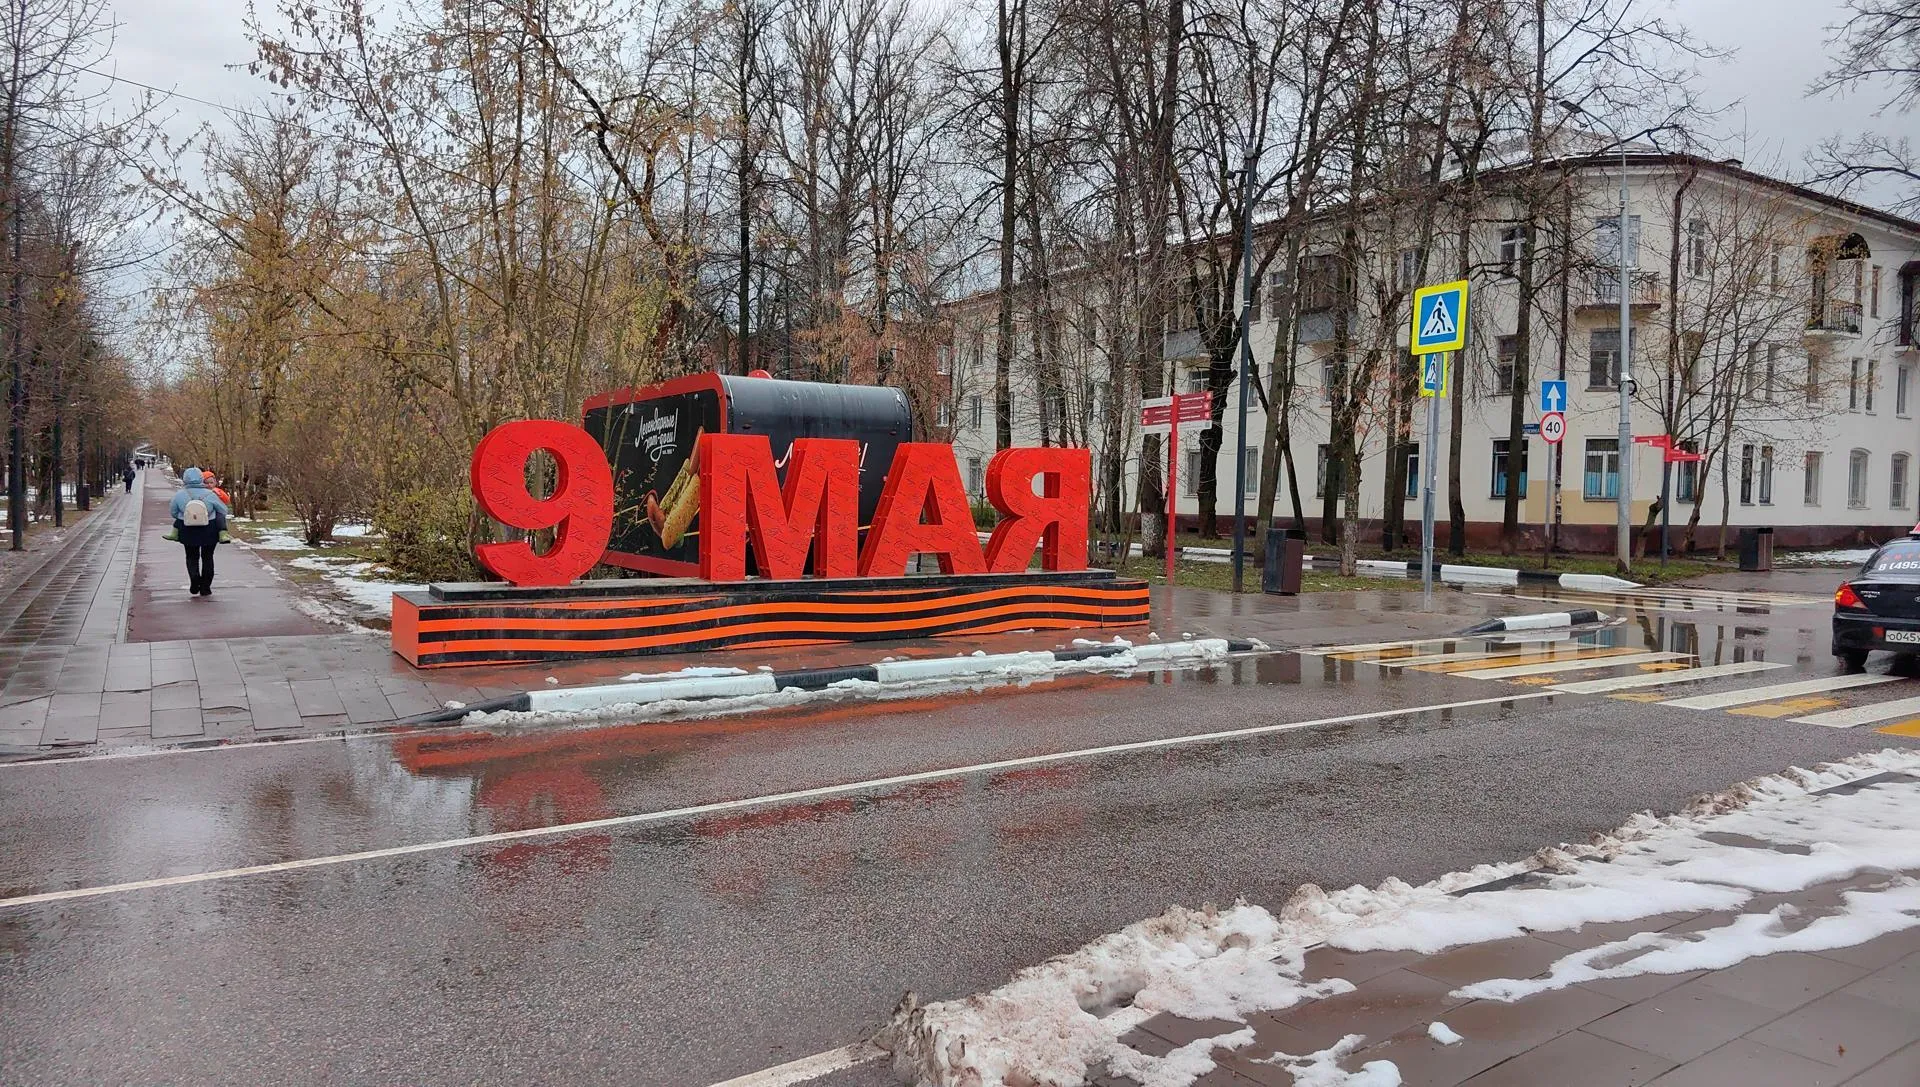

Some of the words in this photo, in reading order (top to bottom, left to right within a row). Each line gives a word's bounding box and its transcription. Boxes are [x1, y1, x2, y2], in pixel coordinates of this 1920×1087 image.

[1545, 421, 1560, 434] 40
[471, 419, 614, 587] 9
[699, 433, 1090, 581] МАЯ
[1889, 561, 1920, 570] (495
